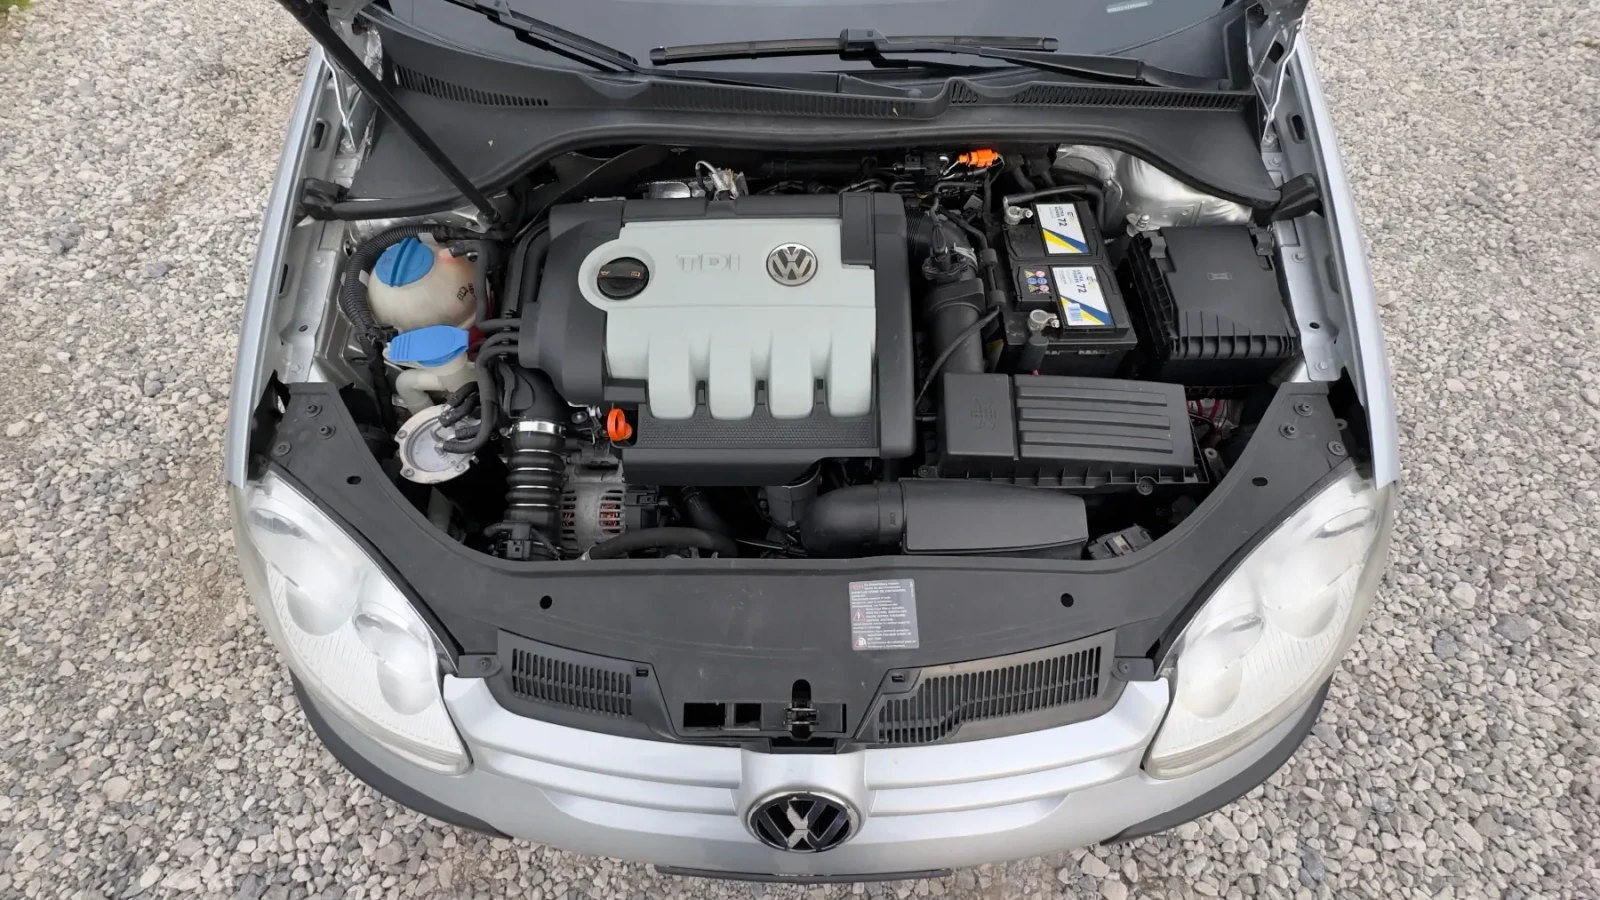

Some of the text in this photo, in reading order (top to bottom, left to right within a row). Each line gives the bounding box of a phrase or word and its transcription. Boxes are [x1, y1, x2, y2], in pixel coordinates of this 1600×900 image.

[1057, 218, 1068, 227] 72
[676, 253, 740, 272] TDI
[767, 243, 817, 286] VW
[1076, 284, 1087, 293] 72
